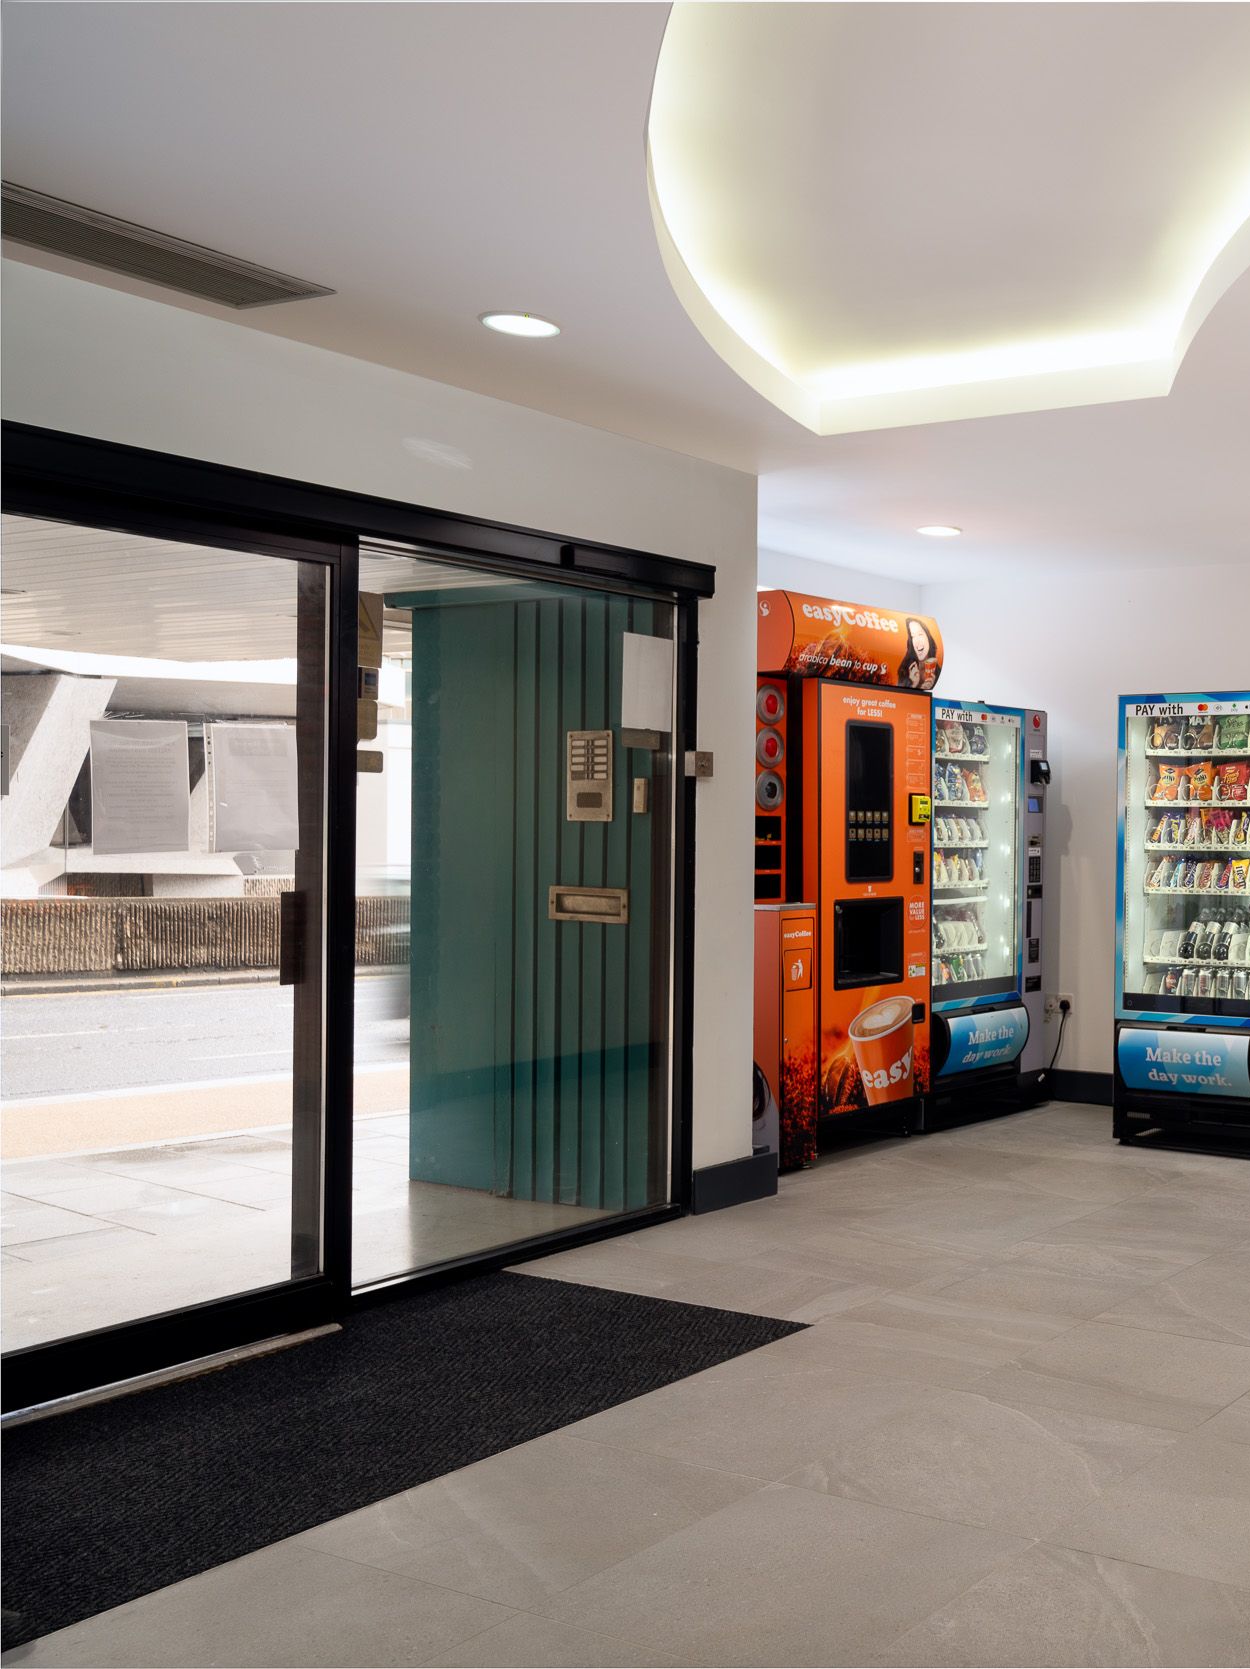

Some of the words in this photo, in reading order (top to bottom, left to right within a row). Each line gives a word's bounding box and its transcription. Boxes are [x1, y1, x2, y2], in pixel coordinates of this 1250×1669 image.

[802, 604, 898, 633] easyCoffee
[798, 653, 829, 665] arabica
[829, 654, 853, 668] bean
[853, 660, 862, 669] to
[862, 663, 878, 675] cup
[842, 696, 861, 707] enjoy
[861, 698, 878, 707] great
[878, 699, 896, 709] coffee
[1136, 704, 1156, 716] PAY
[1159, 703, 1184, 715] with
[857, 707, 867, 716] for
[941, 708, 955, 719] PAY
[956, 710, 973, 722] with
[909, 901, 925, 909] MORE
[784, 930, 812, 938] easyCoffee
[968, 1028, 997, 1046] Make
[998, 1025, 1015, 1039] the
[962, 1050, 983, 1064] day
[1145, 1047, 1191, 1064] Make
[1194, 1050, 1222, 1066] the
[861, 1046, 913, 1089] easy
[1148, 1068, 1179, 1085] day
[1181, 1074, 1233, 1087] work.
